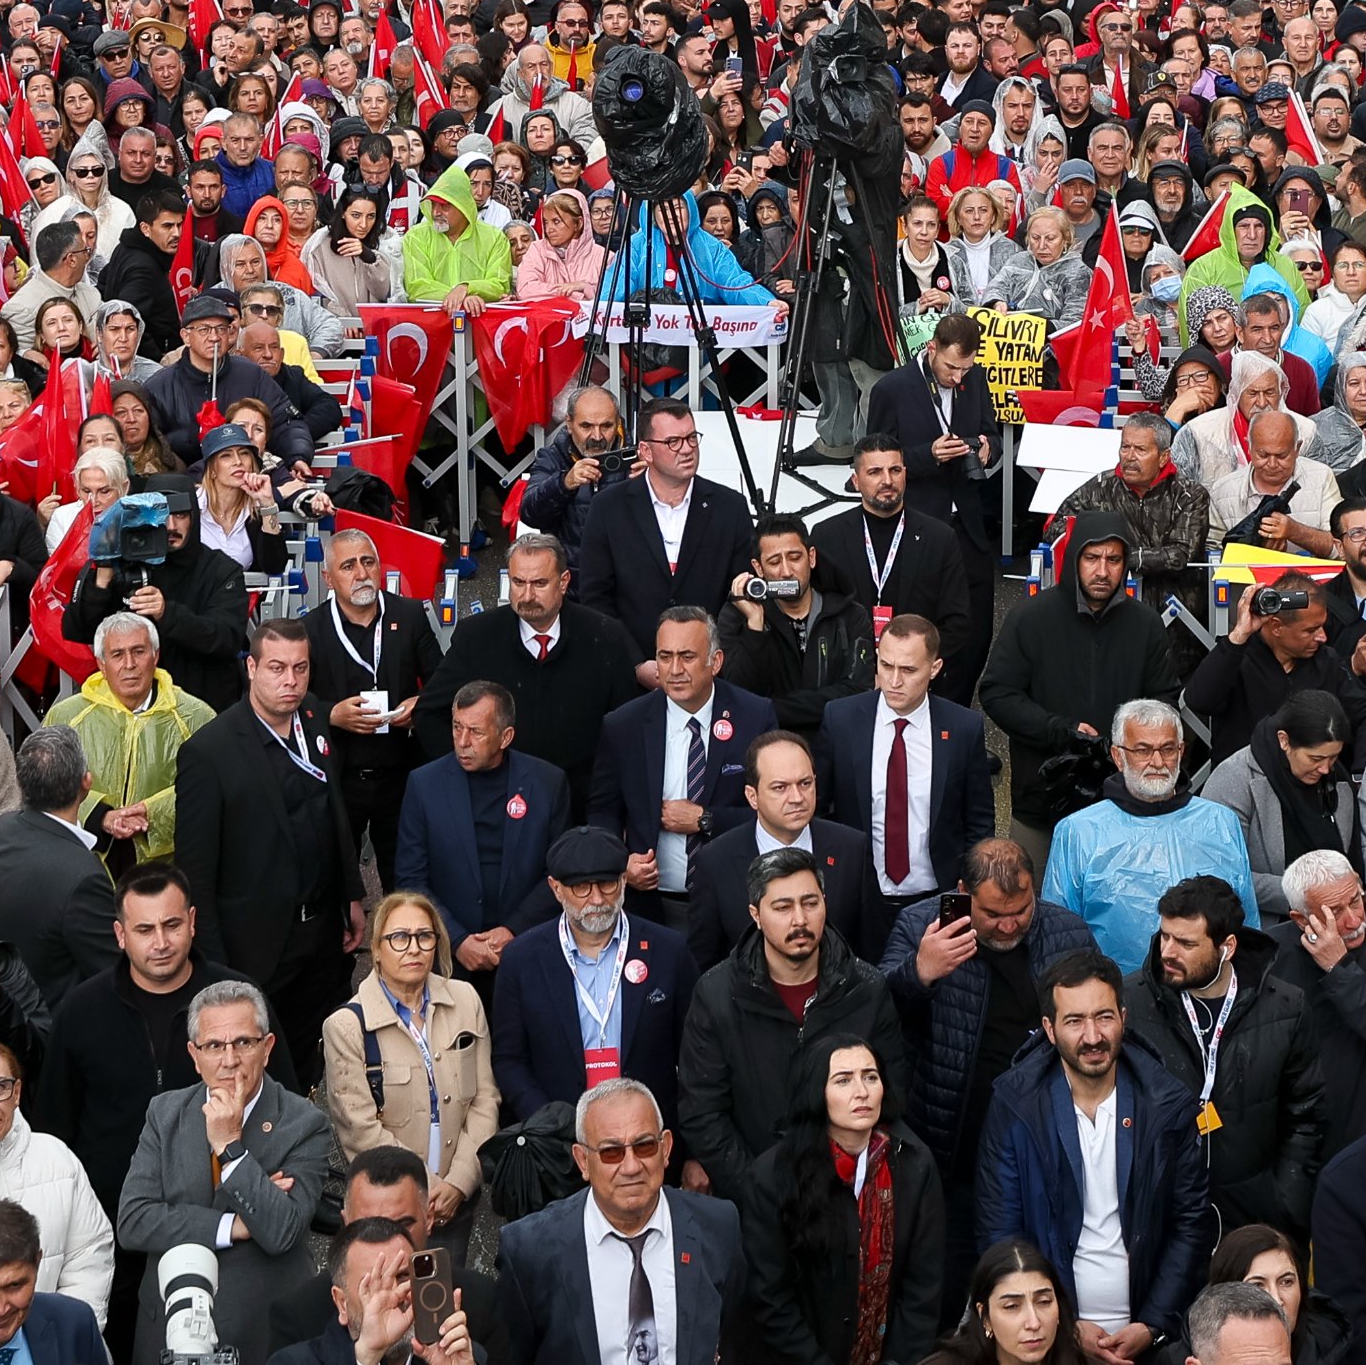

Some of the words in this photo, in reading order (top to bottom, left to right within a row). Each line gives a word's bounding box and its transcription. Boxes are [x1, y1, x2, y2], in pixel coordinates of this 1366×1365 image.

[655, 314, 680, 330] Yok
[713, 317, 757, 336] Başına
[995, 342, 1045, 362] YATAN
[72, 579, 81, 602] Canon
[585, 1061, 617, 1070] PROTOKOL
